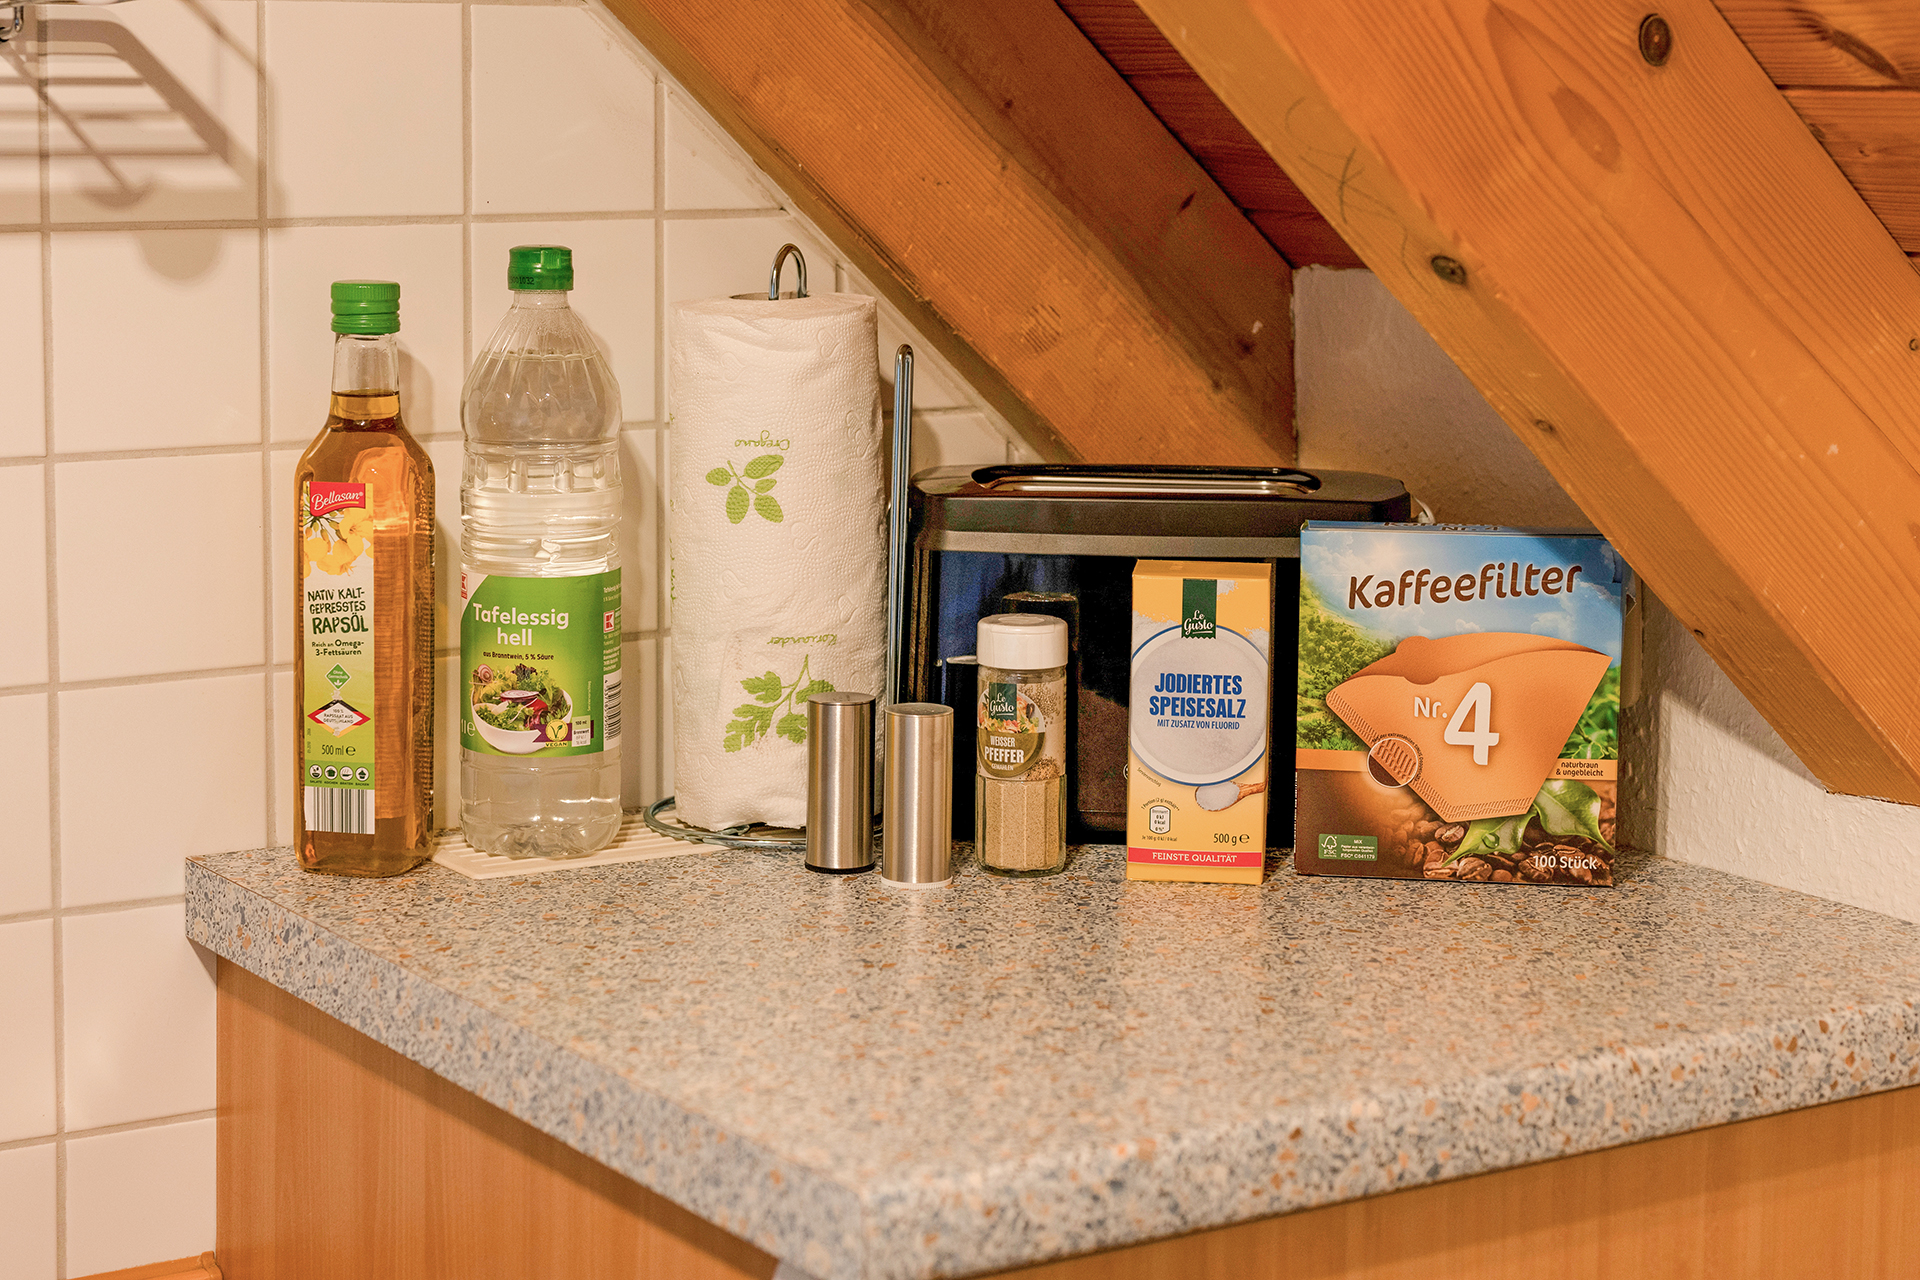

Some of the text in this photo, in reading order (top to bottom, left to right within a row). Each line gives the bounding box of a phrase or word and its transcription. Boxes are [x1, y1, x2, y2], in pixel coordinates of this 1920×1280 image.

[734, 430, 790, 450] Oregano
[1348, 562, 1582, 610] Kaffeefilter
[308, 587, 364, 602] NATIV KALT-
[310, 600, 366, 614] GEPRESSTES
[472, 602, 569, 630] Tafelessig
[1192, 610, 1204, 620] Le
[312, 613, 368, 634] RAPSÖL
[1184, 618, 1214, 635] Gusto
[497, 626, 532, 646] hell
[766, 634, 837, 648] Koriander
[335, 639, 364, 649] Omega-
[316, 648, 362, 656] 3-Fettsäuren
[492, 651, 524, 661] Branntwein,
[1154, 672, 1242, 695] JODIERTES
[996, 692, 1006, 702] Le
[990, 700, 1014, 716] Gusto
[1149, 696, 1246, 718] SPEISESALZ
[1157, 719, 1240, 730] MIT ZUSATZ VON FLUORID
[1414, 682, 1500, 765] Nr. 4
[990, 735, 1016, 747] WEISSER
[322, 744, 334, 755] 500
[335, 745, 344, 755] ml
[985, 746, 1024, 763] PFEFFER
[1562, 769, 1603, 777] ungebleicht
[1213, 833, 1229, 843] 500
[1231, 835, 1237, 846] g
[1152, 852, 1237, 863] FEINSTE QUALITÄT
[1533, 855, 1597, 869] 100 Stück
